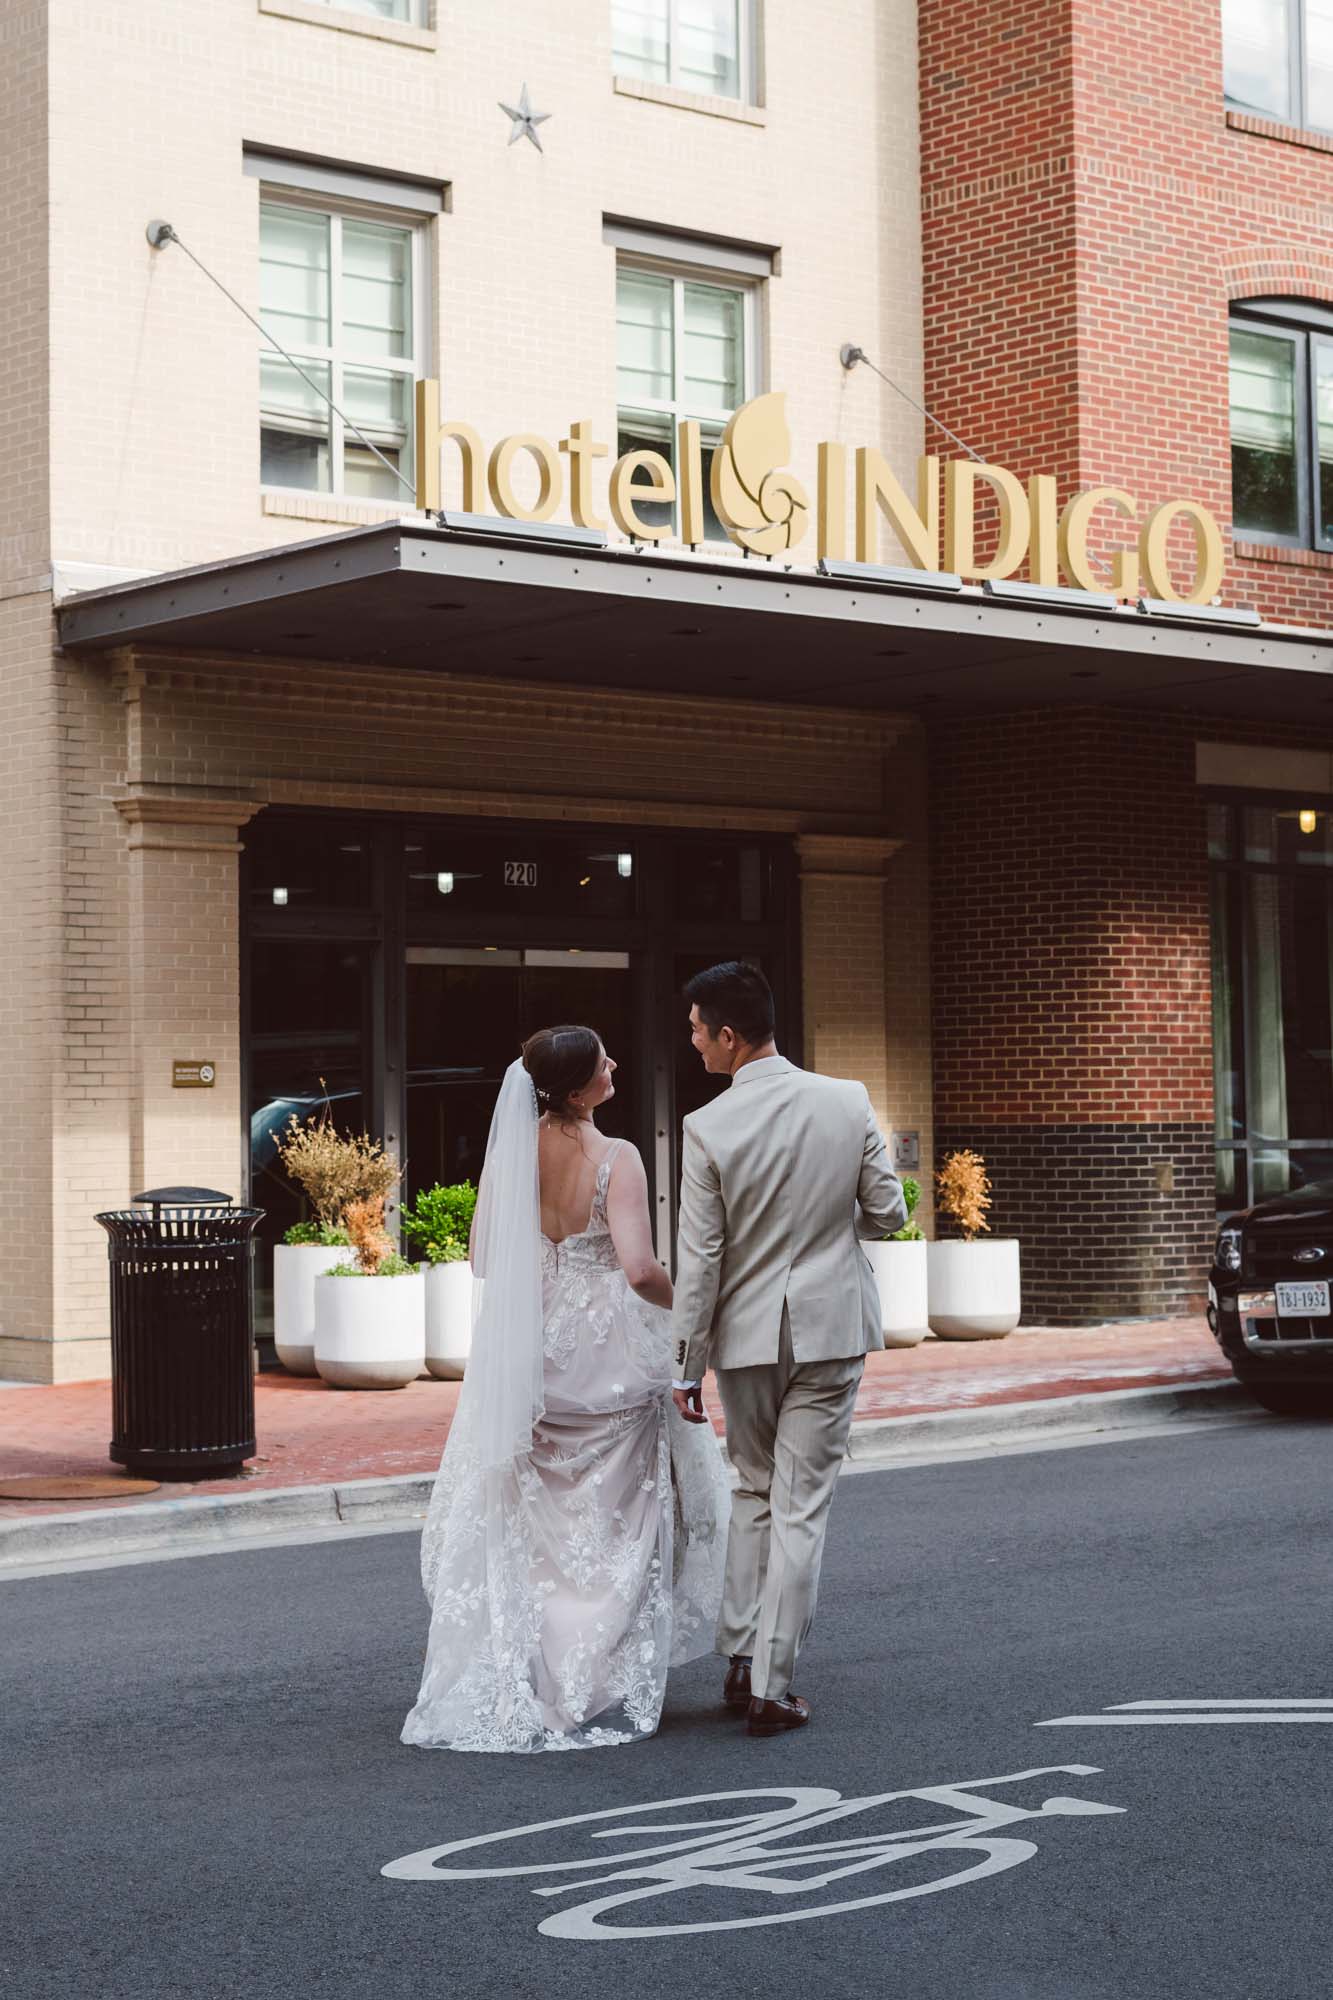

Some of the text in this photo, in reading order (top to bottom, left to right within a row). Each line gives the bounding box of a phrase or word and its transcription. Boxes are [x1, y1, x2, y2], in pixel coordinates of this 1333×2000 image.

[416, 379, 1224, 605] hotel INDIGO
[506, 863, 535, 885] 220
[1279, 1291, 1326, 1308] TBJ-1932
